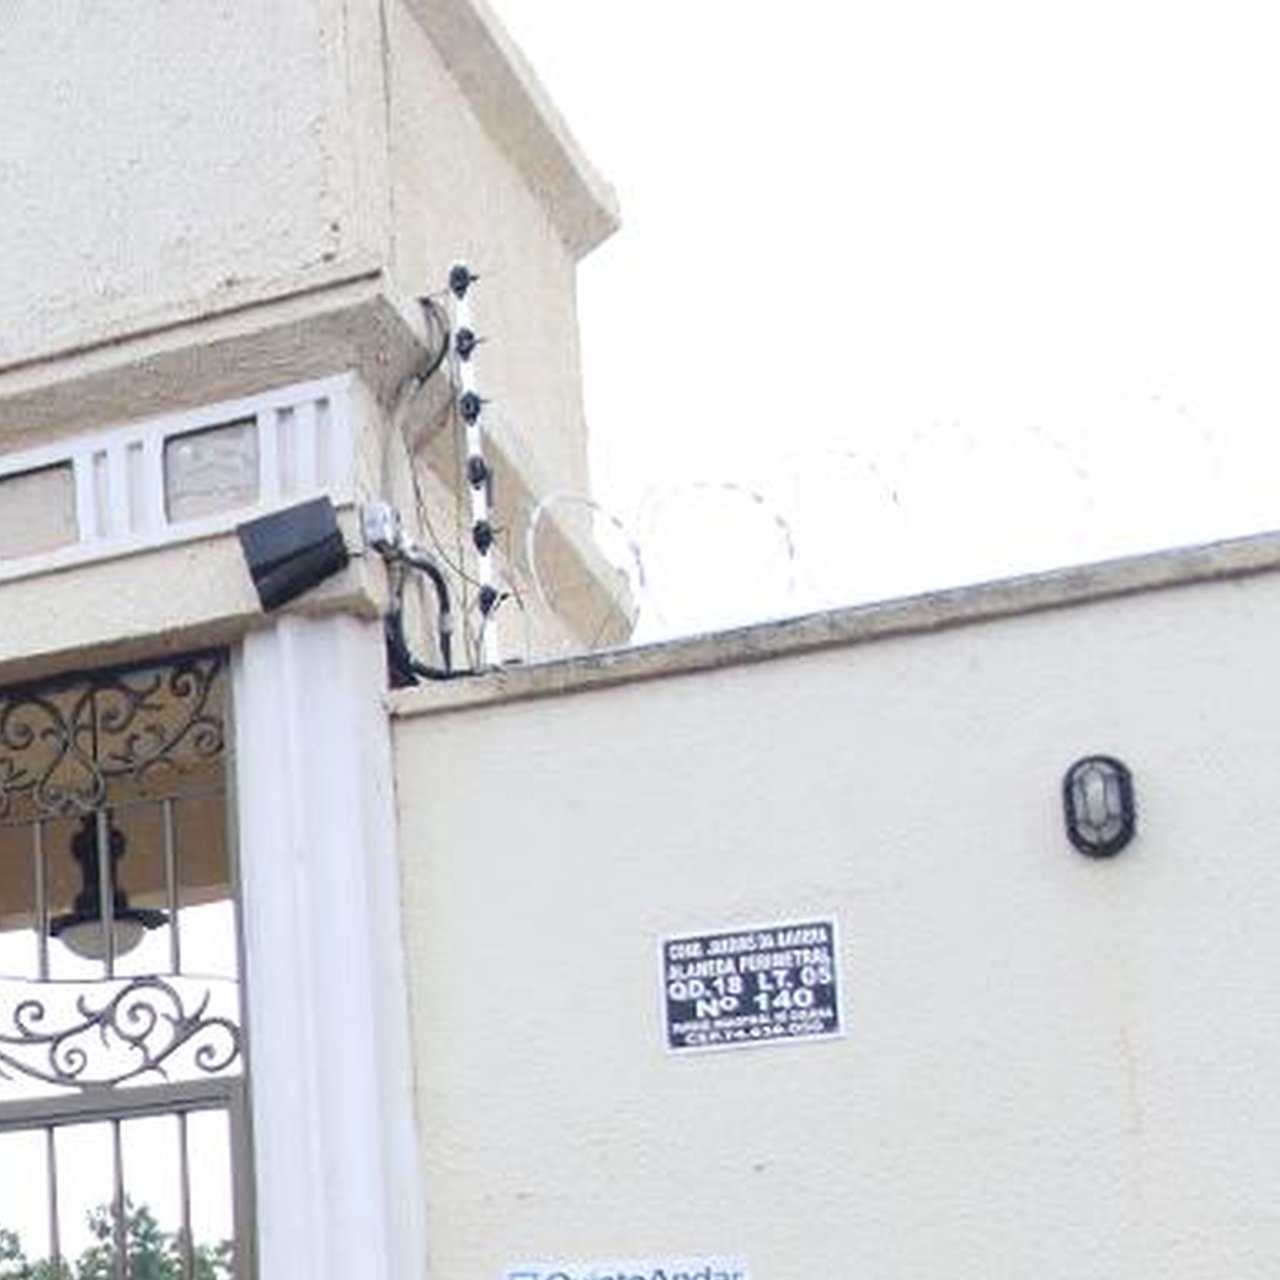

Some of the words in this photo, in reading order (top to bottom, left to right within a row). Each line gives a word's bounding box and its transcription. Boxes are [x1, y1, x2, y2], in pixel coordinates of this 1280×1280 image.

[669, 975, 742, 1000] QD.18
[758, 969, 793, 991] LT.
[800, 965, 832, 986] 05
[754, 988, 814, 1010] 140
